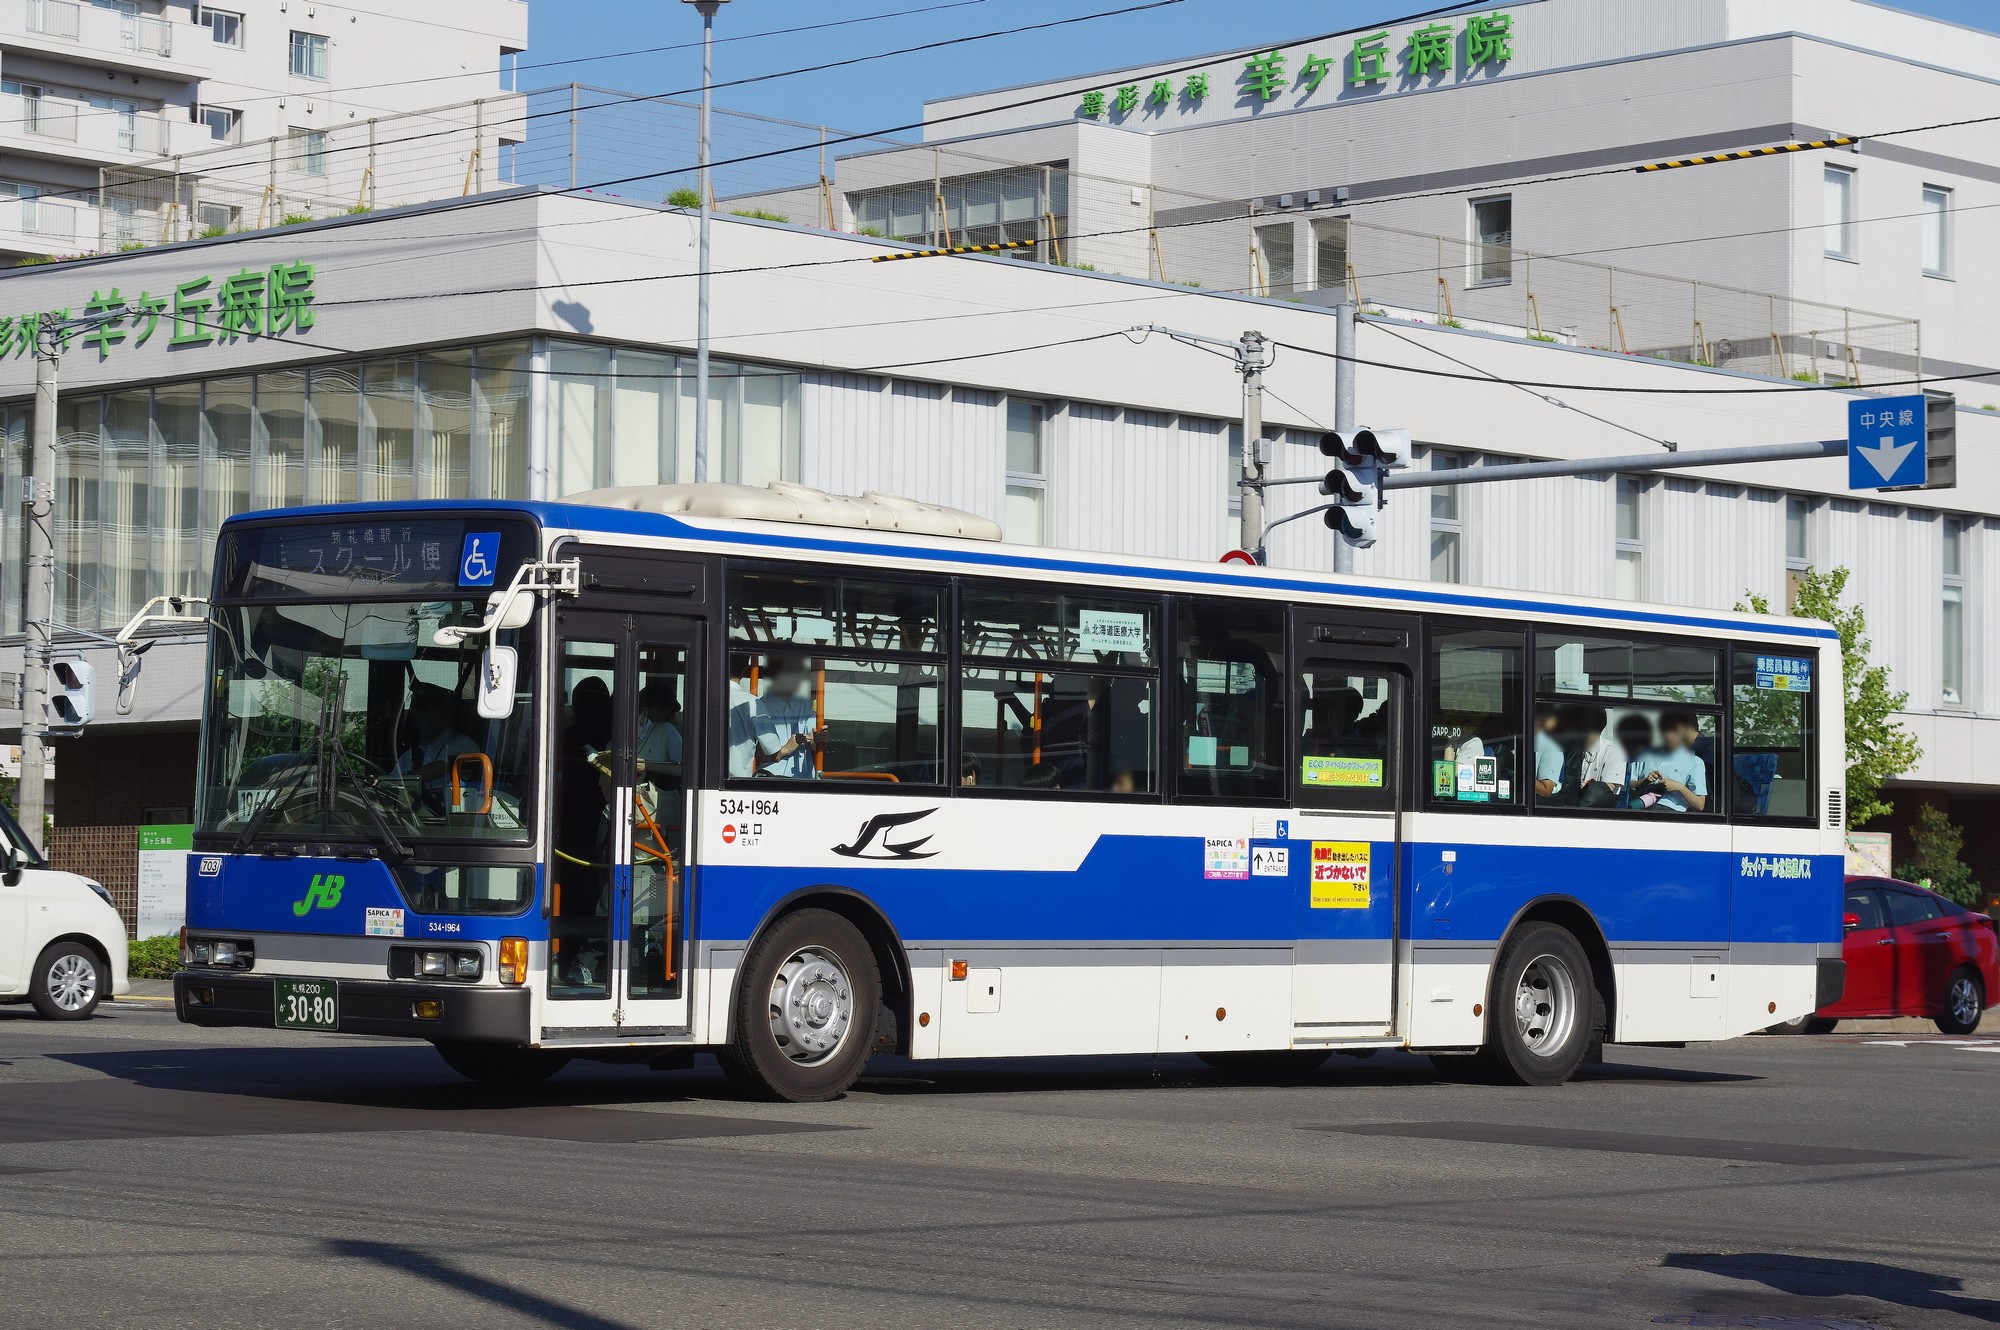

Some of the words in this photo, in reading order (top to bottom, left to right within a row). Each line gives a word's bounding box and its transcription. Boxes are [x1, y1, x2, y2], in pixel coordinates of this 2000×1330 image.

[1083, 72, 1210, 116] 整形外科
[1860, 409, 1914, 430] 中央線
[308, 541, 441, 575] スクール便
[1092, 623, 1141, 638] 北海道医療大学
[1757, 657, 1800, 674] 乗務員募集
[1308, 760, 1324, 769] ECO
[720, 799, 779, 815] 534-1964
[740, 823, 762, 835] 出口
[742, 838, 759, 846] EXIT
[1207, 839, 1233, 848] SAPICA
[1267, 851, 1285, 863] 入口
[202, 860, 217, 872] 703
[1264, 865, 1287, 873] ENTRANCE
[1315, 865, 1366, 880] 近づかないで
[1352, 883, 1368, 891] 下さい
[367, 909, 390, 917] SAPICA
[428, 922, 461, 933] 534-1964
[287, 995, 335, 1024] 30-80
